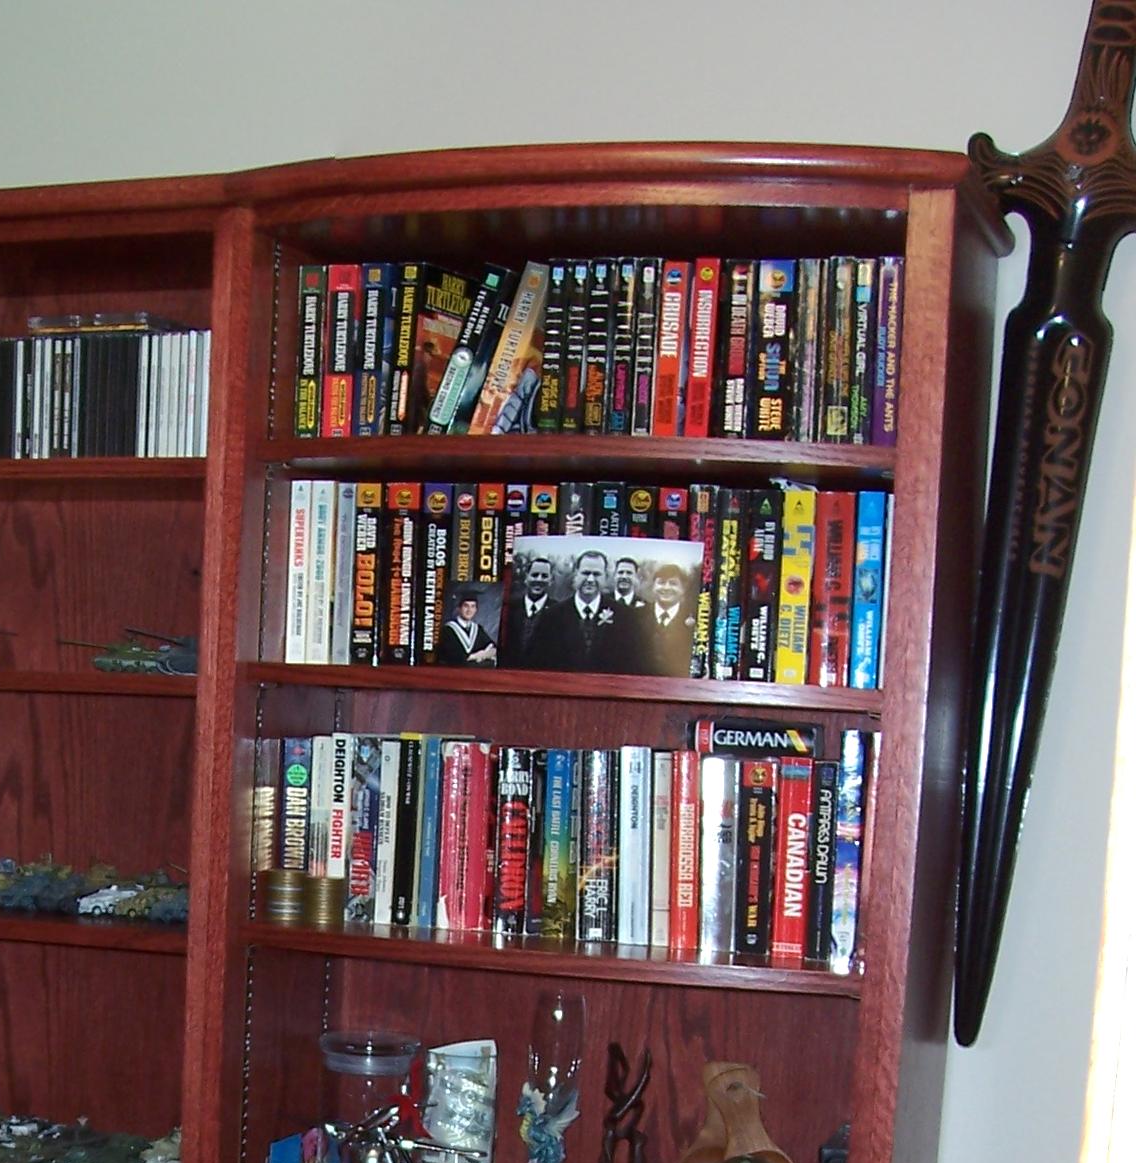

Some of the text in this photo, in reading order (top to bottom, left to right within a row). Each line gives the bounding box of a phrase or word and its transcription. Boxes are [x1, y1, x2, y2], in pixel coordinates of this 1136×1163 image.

[397, 286, 414, 367] HARRY TURTLEDOVE
[514, 291, 535, 324] HARRY
[587, 290, 609, 363] ALIENS
[659, 291, 681, 358] CRUSADE
[730, 306, 746, 335] DEATH
[763, 302, 776, 338] WEBER
[775, 304, 787, 336] DAVID
[303, 324, 316, 375] TURTLEDOVE
[334, 320, 348, 372] TURTLEDOVE
[364, 318, 378, 370] TURTLEDOVE
[543, 306, 564, 370] ALIENS
[692, 289, 713, 378] INSURRECTION
[855, 302, 868, 377] VIRTUAL GIRL
[884, 303, 897, 432] HACKER AND THE ANTS
[758, 397, 771, 431] WHITE
[770, 398, 783, 430] STEVE
[1028, 331, 1095, 579] CONAN
[294, 508, 305, 567] SUPERTANKS
[355, 514, 368, 551] WEBER
[367, 517, 377, 548] DAVID
[403, 517, 413, 545] JOHN
[436, 528, 447, 567] BOLOS
[458, 519, 470, 551] BOLO
[480, 516, 493, 570] BOLO
[354, 553, 376, 627] BOLO!
[423, 523, 437, 651] CREATED BY KEITH LAUMER
[726, 606, 741, 652] WILLIAM
[750, 618, 759, 649] DIETZ
[758, 605, 768, 651] WILLIAM
[778, 618, 791, 649] DIETZ
[791, 605, 806, 653] WILLIAM
[714, 728, 789, 749] GERMAN
[330, 739, 346, 859] DEIGHTON FIGHTER
[500, 783, 529, 796] BOND
[630, 784, 640, 829] DEIGHTON
[284, 786, 307, 870] DAN BROWN
[547, 791, 561, 904] LAST RYAN
[677, 803, 695, 908] BARBAROSSA RED
[783, 812, 806, 917] CANADIAN
[584, 879, 596, 918] HARRY
[596, 879, 608, 904] ERIC
